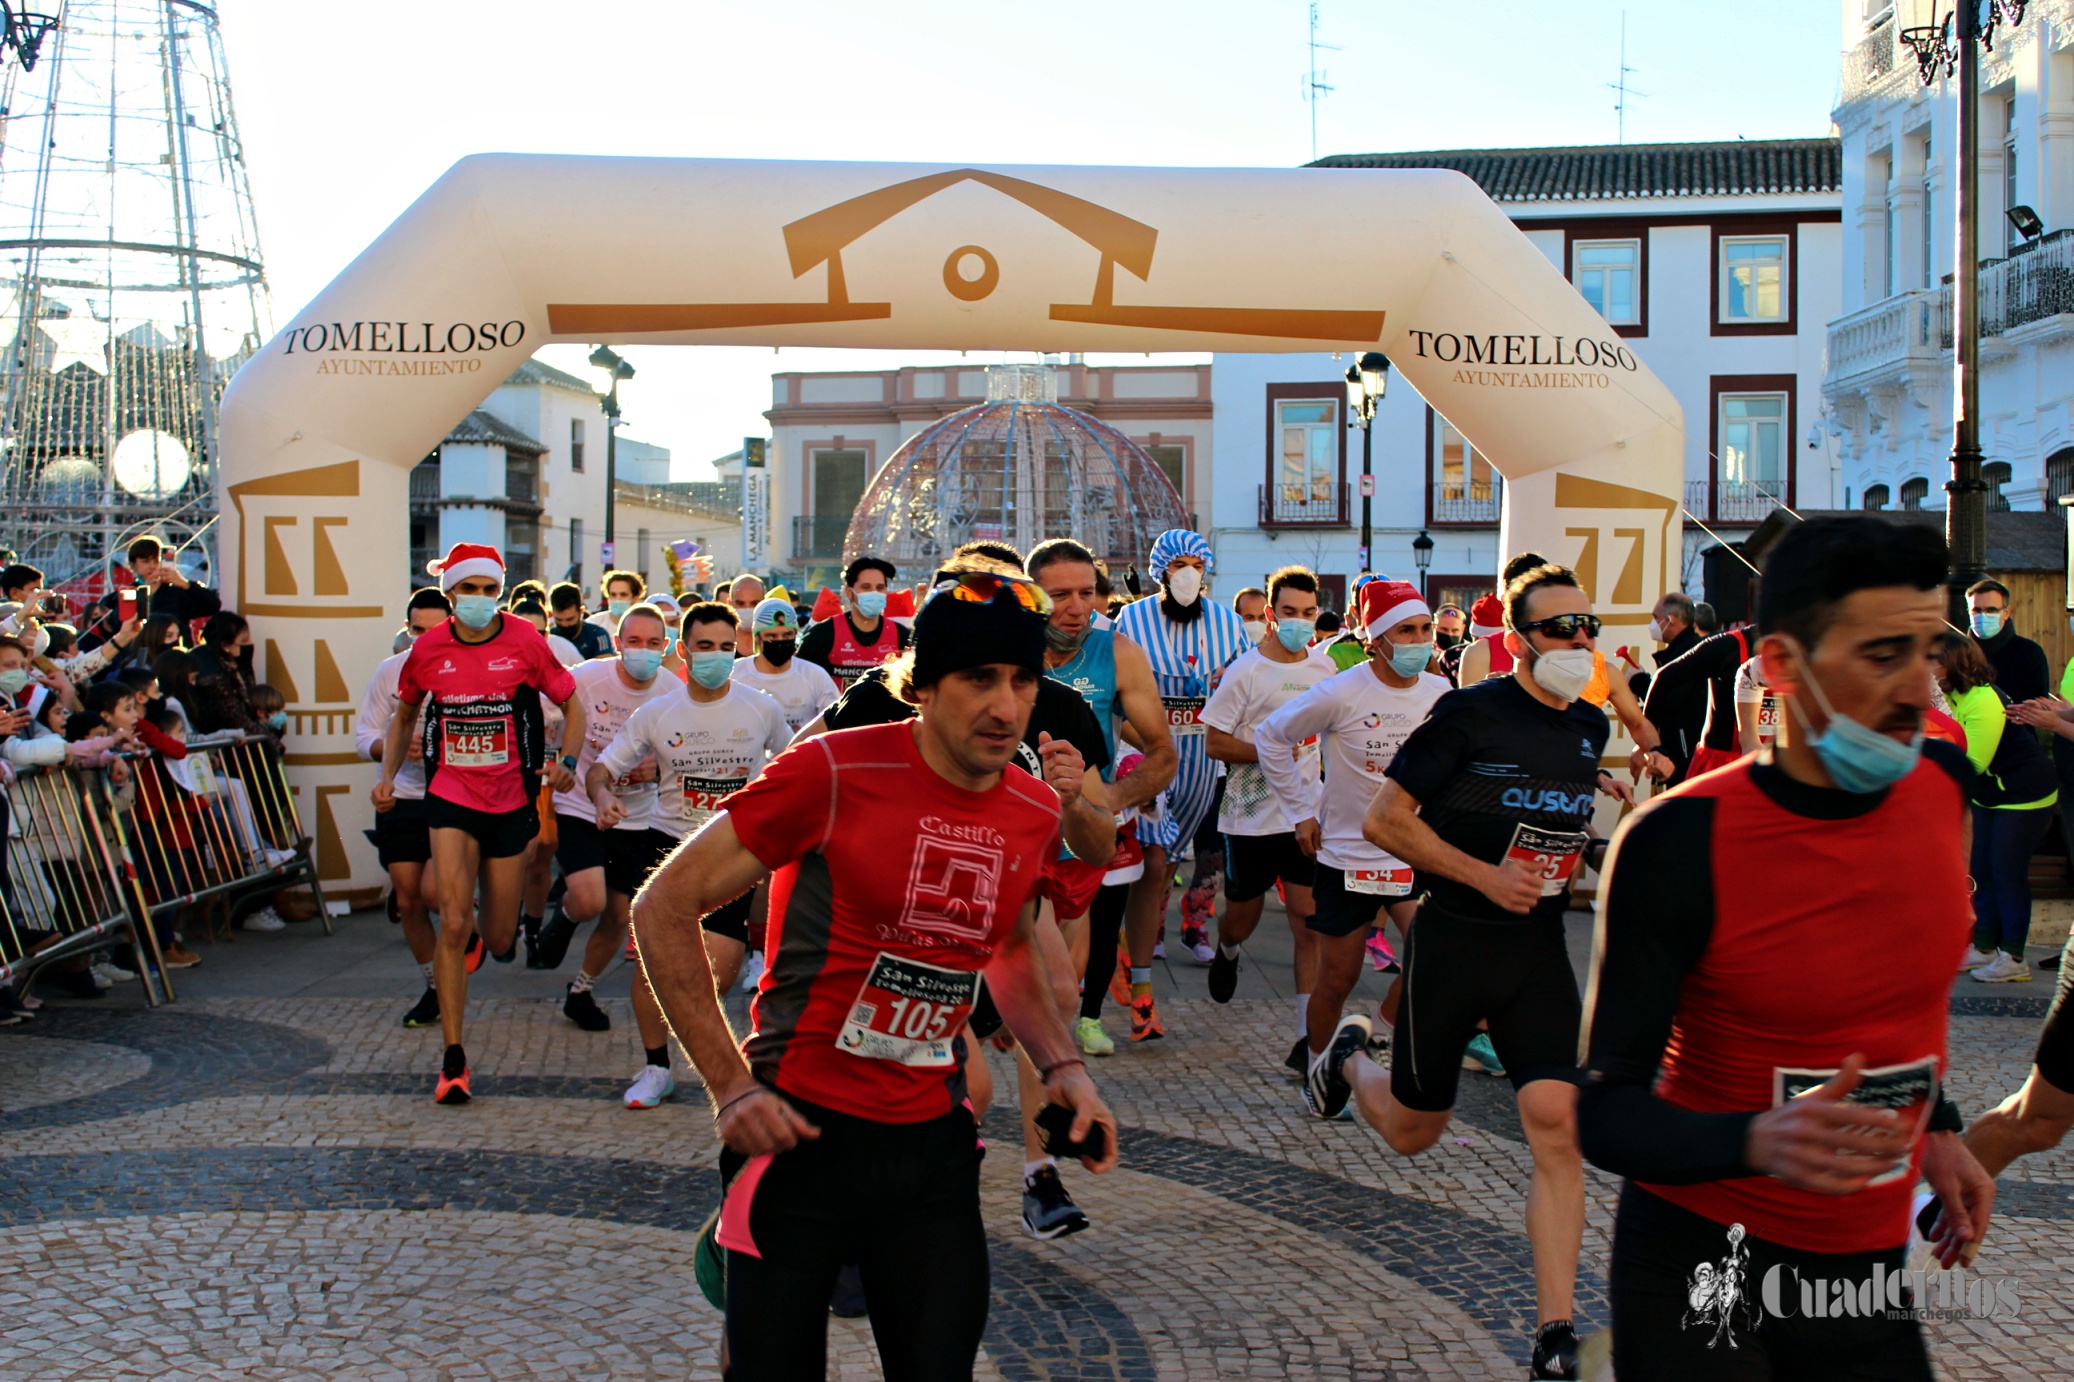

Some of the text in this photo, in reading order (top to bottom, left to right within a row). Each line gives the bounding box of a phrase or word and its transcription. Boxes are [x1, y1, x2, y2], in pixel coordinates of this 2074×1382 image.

[283, 320, 525, 354] TOMELLOSO
[1409, 330, 1638, 372] TOMELLOSO
[316, 358, 481, 376] AYUNTAMIENTO
[1453, 369, 1609, 389] AYUNTAMIENTO
[748, 474, 757, 561] LA MANCHEGA
[593, 722, 611, 733] San
[684, 730, 710, 739] GRUPO
[456, 735, 494, 753] 445
[1366, 740, 1389, 749] San
[672, 756, 754, 767] San Silvestre
[919, 814, 1006, 847] Castillo
[881, 966, 971, 995] San Silvestre
[887, 996, 955, 1040] 105
